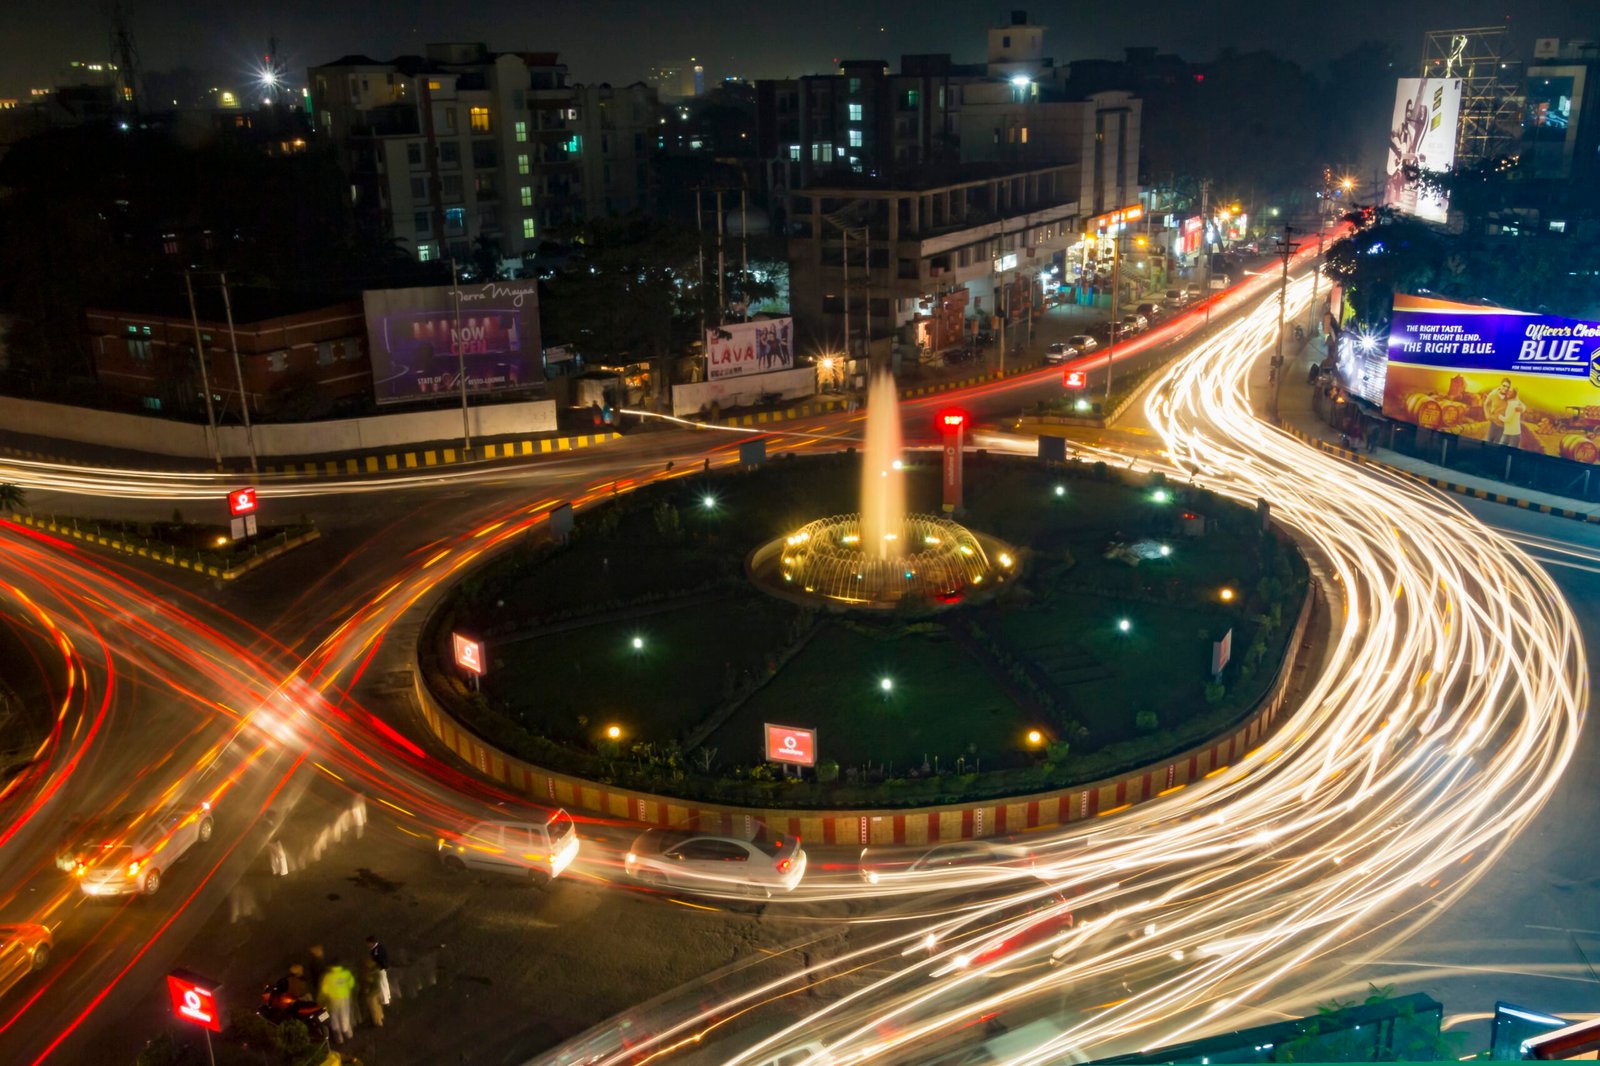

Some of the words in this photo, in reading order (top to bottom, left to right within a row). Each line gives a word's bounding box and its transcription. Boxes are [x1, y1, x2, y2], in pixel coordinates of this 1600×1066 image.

[448, 290, 486, 302] Terra
[451, 326, 485, 342] NOW
[1406, 324, 1418, 332] THE
[1419, 324, 1440, 332] RIGHT
[1441, 325, 1464, 333] TASTE.
[1525, 323, 1571, 340] Officer's
[1419, 333, 1431, 341] THE
[1432, 333, 1454, 341] RIGHT
[1455, 334, 1481, 342] BLEND.
[451, 340, 487, 354] OPEN
[1403, 342, 1423, 352] THE
[1424, 343, 1460, 353] RIGHT
[1461, 343, 1496, 354] BLUE.
[1517, 340, 1584, 360] BLUE
[711, 346, 754, 365] LAVA
